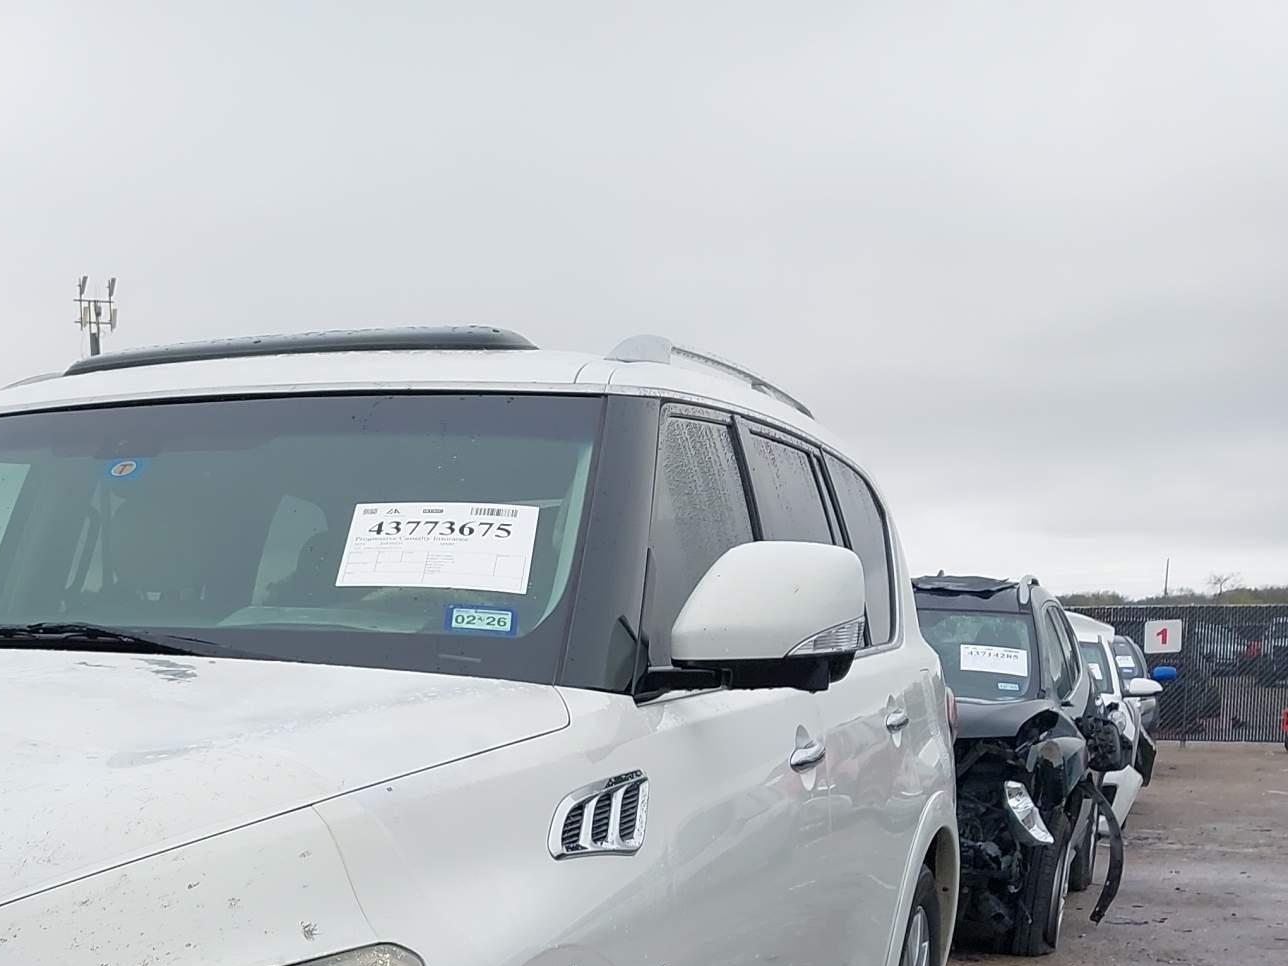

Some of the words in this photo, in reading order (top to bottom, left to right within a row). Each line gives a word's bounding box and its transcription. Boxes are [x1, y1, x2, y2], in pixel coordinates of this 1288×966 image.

[368, 520, 513, 539] 43773675
[454, 614, 476, 625] 02
[485, 616, 507, 627] 26
[1156, 628, 1168, 645] 1
